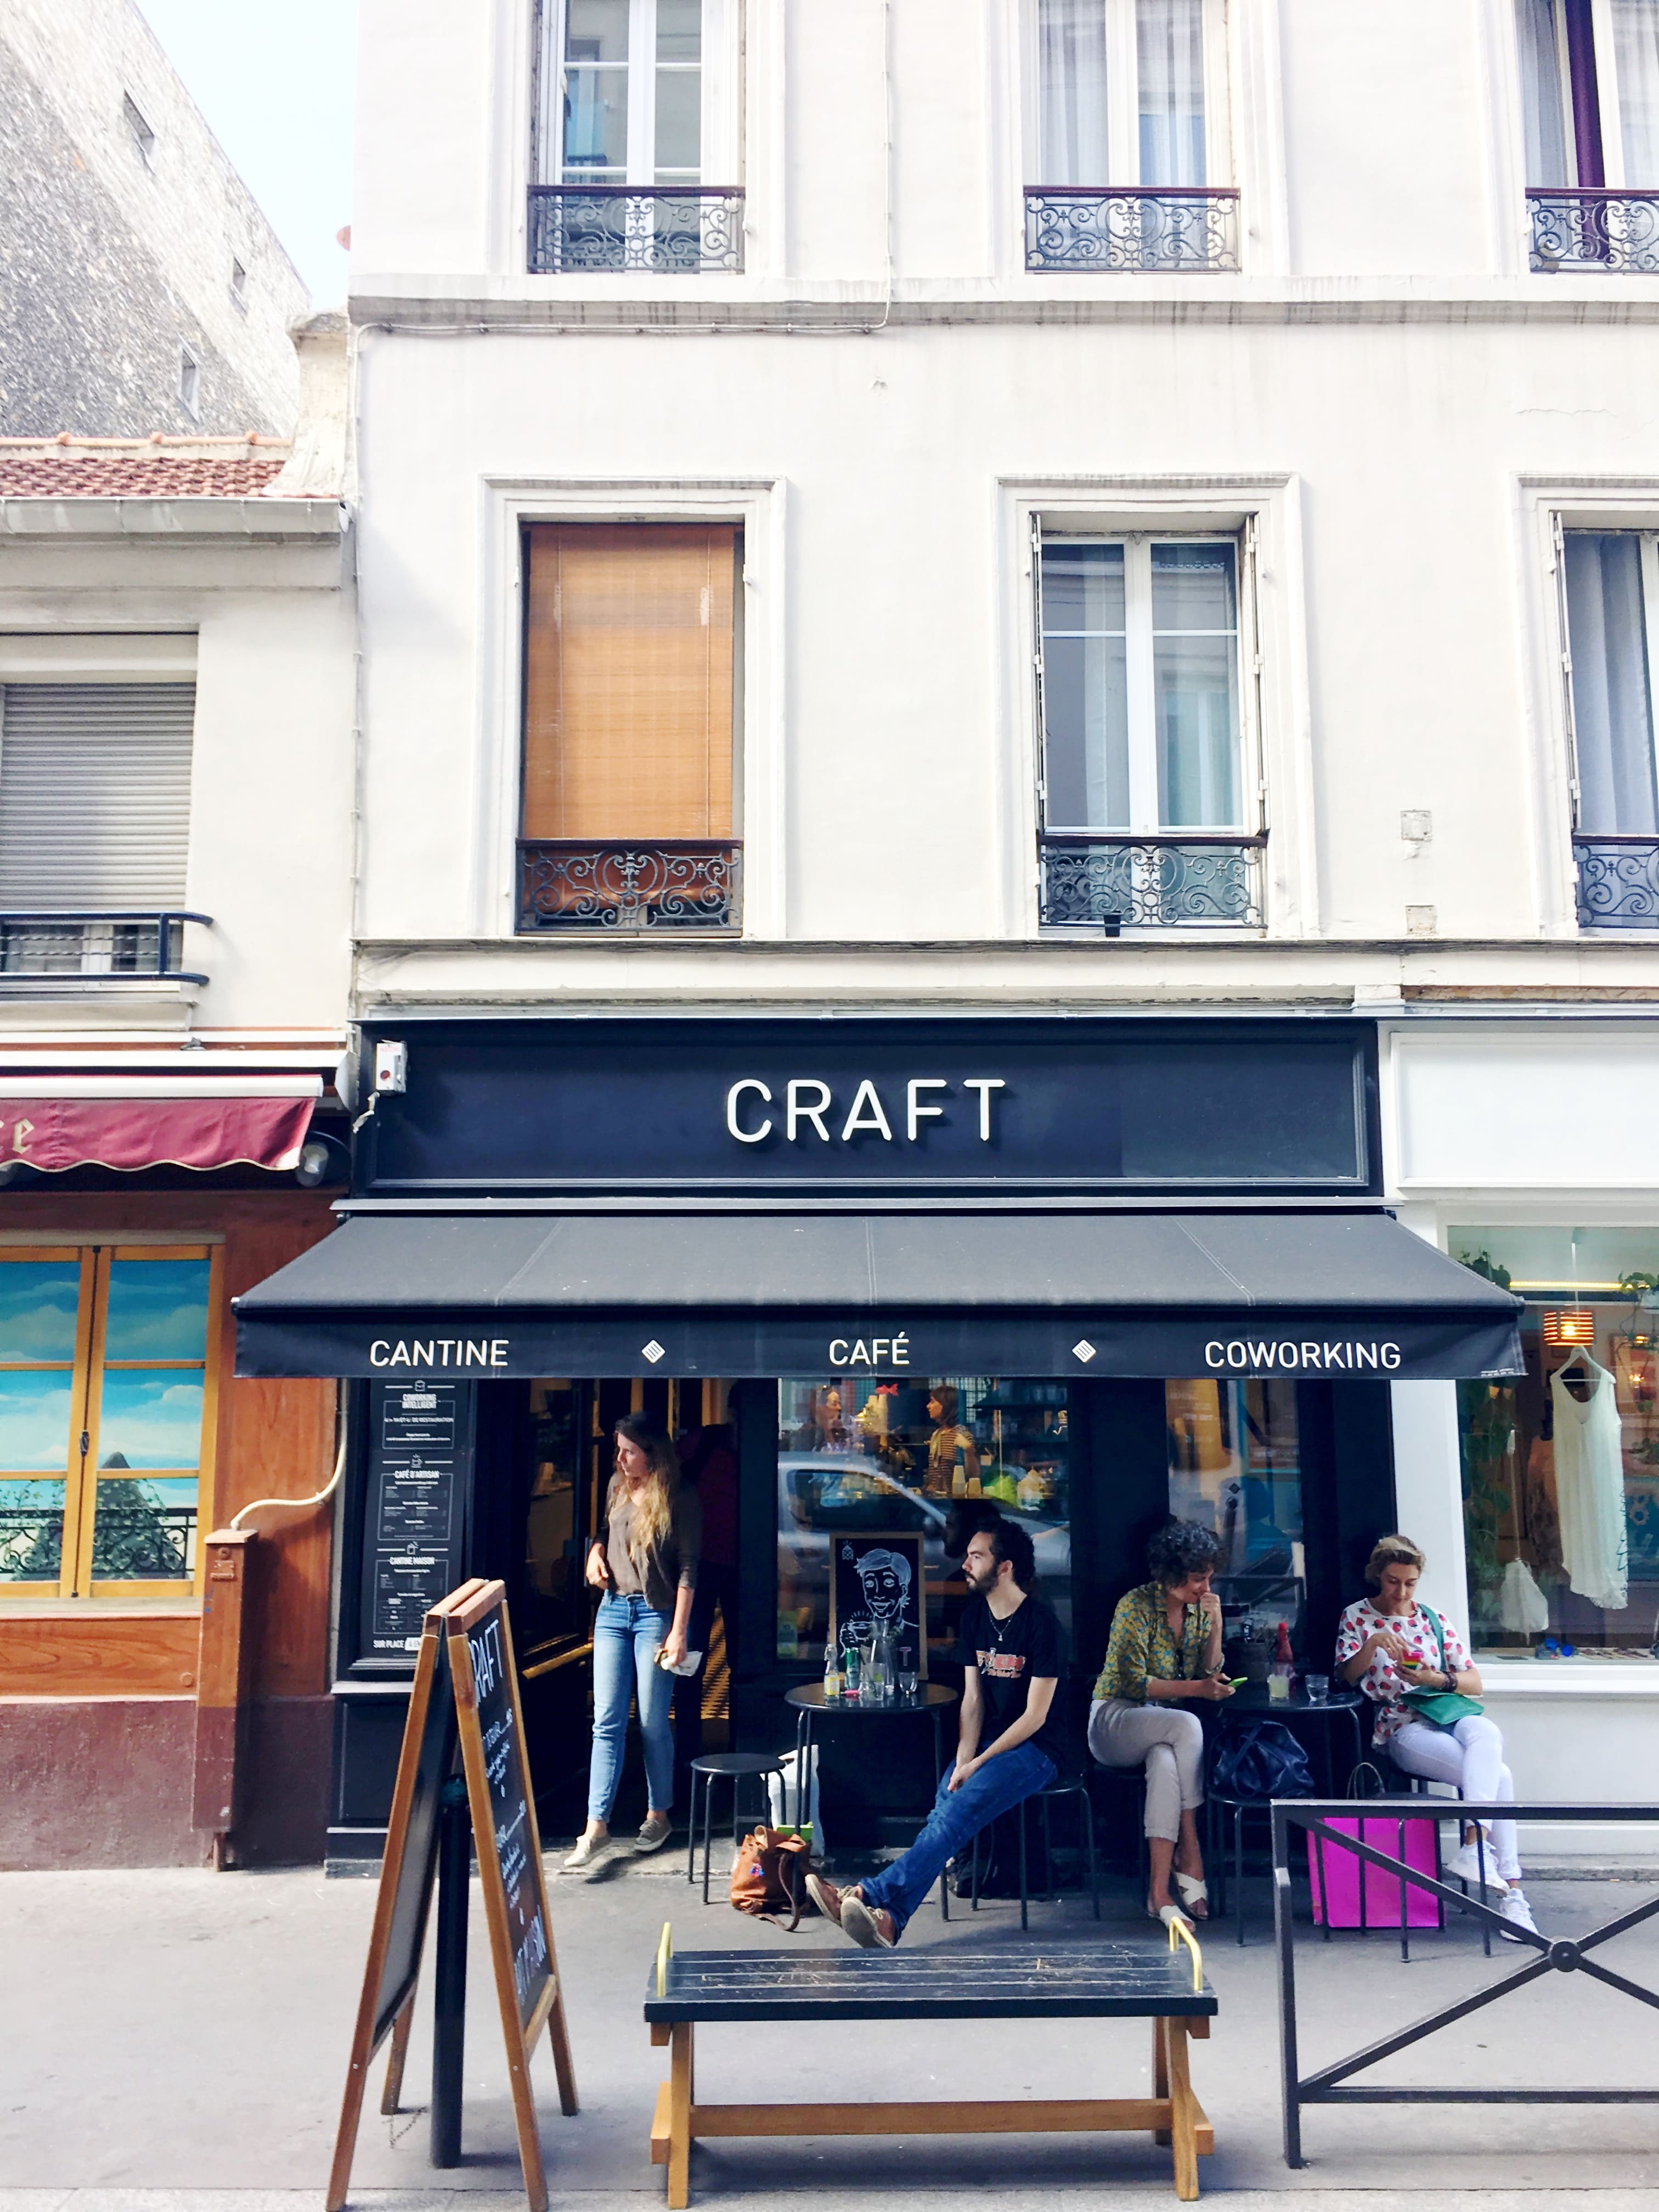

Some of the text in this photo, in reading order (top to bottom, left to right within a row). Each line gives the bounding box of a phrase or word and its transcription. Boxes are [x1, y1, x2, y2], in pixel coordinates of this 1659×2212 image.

[727, 1079, 1006, 1142] CRAFT
[370, 1340, 509, 1367] CANTINE
[830, 1331, 910, 1365] CAFÉ
[1205, 1341, 1401, 1369] COWORKING
[373, 1639, 386, 1649] SUR
[386, 1639, 404, 1649] PLACE
